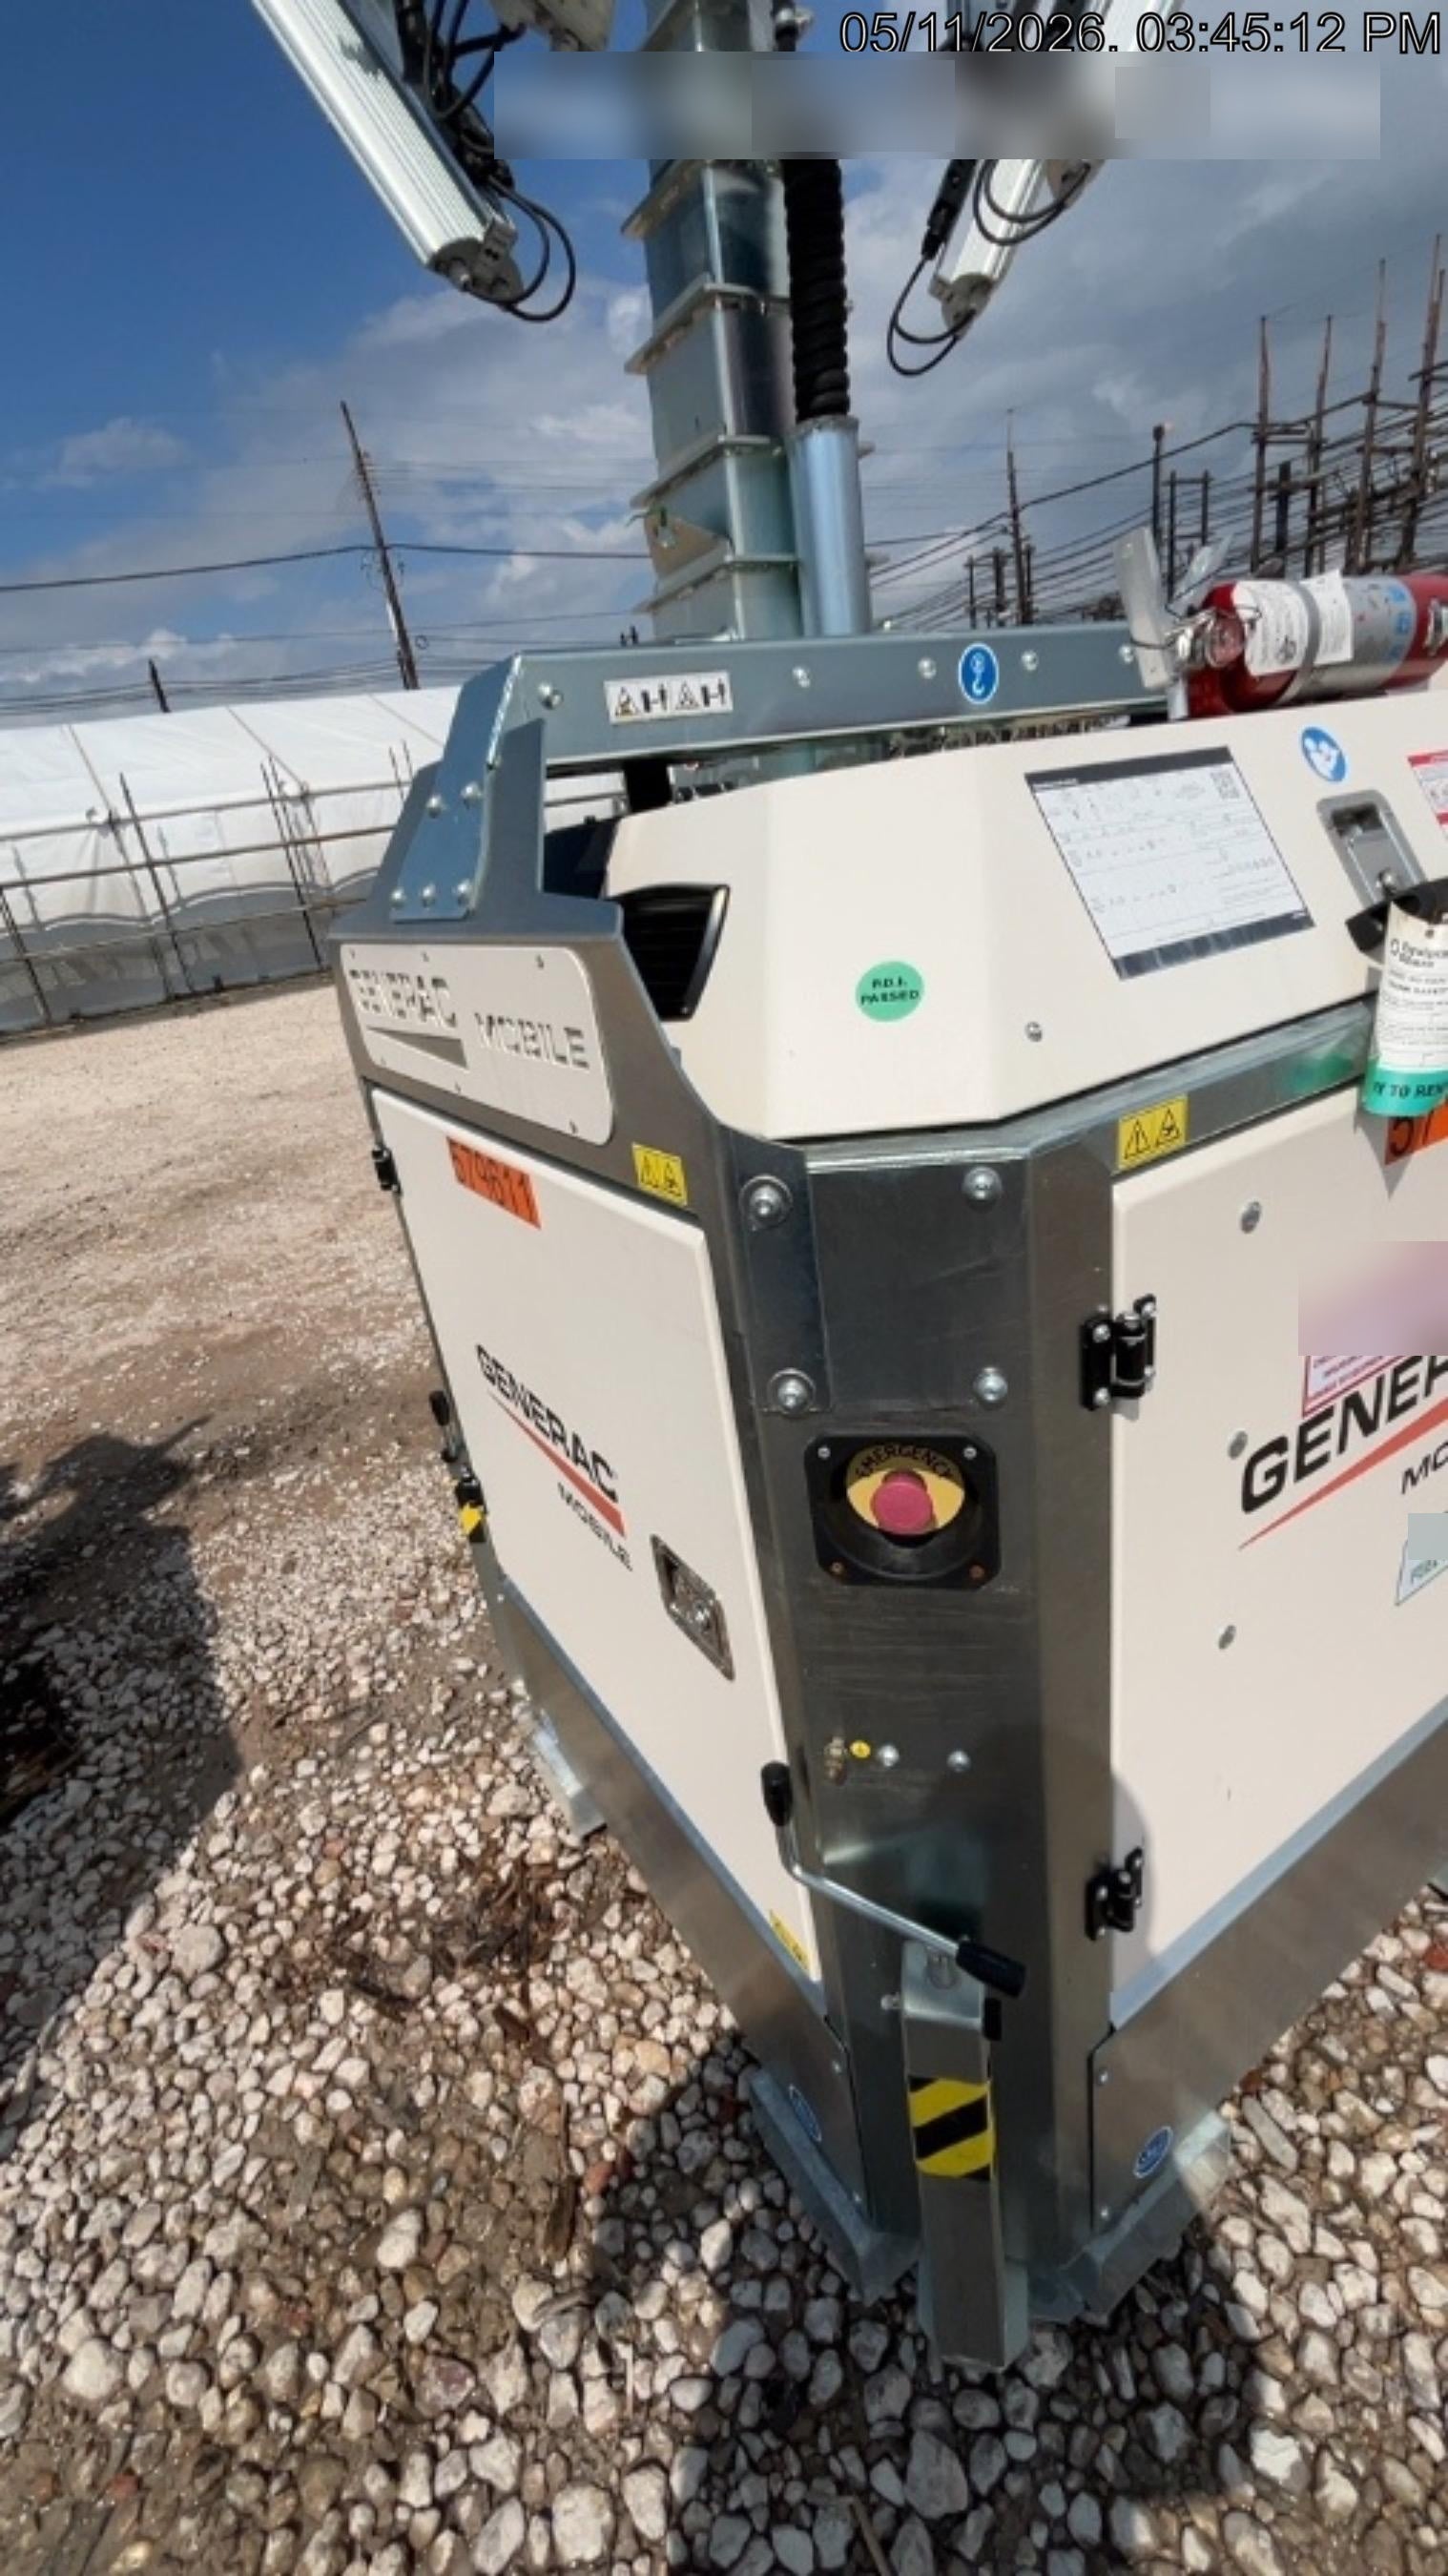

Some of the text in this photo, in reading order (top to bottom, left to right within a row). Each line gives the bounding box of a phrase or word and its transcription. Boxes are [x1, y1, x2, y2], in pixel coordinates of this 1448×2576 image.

[860, 989, 920, 1006] PASSED
[474, 1012, 590, 1070] MOBILE
[1390, 1084, 1411, 1099] TO
[476, 1343, 619, 1504] GENERAC
[855, 1443, 956, 1478] EMERGENCY
[557, 1481, 633, 1572] MOBILE
